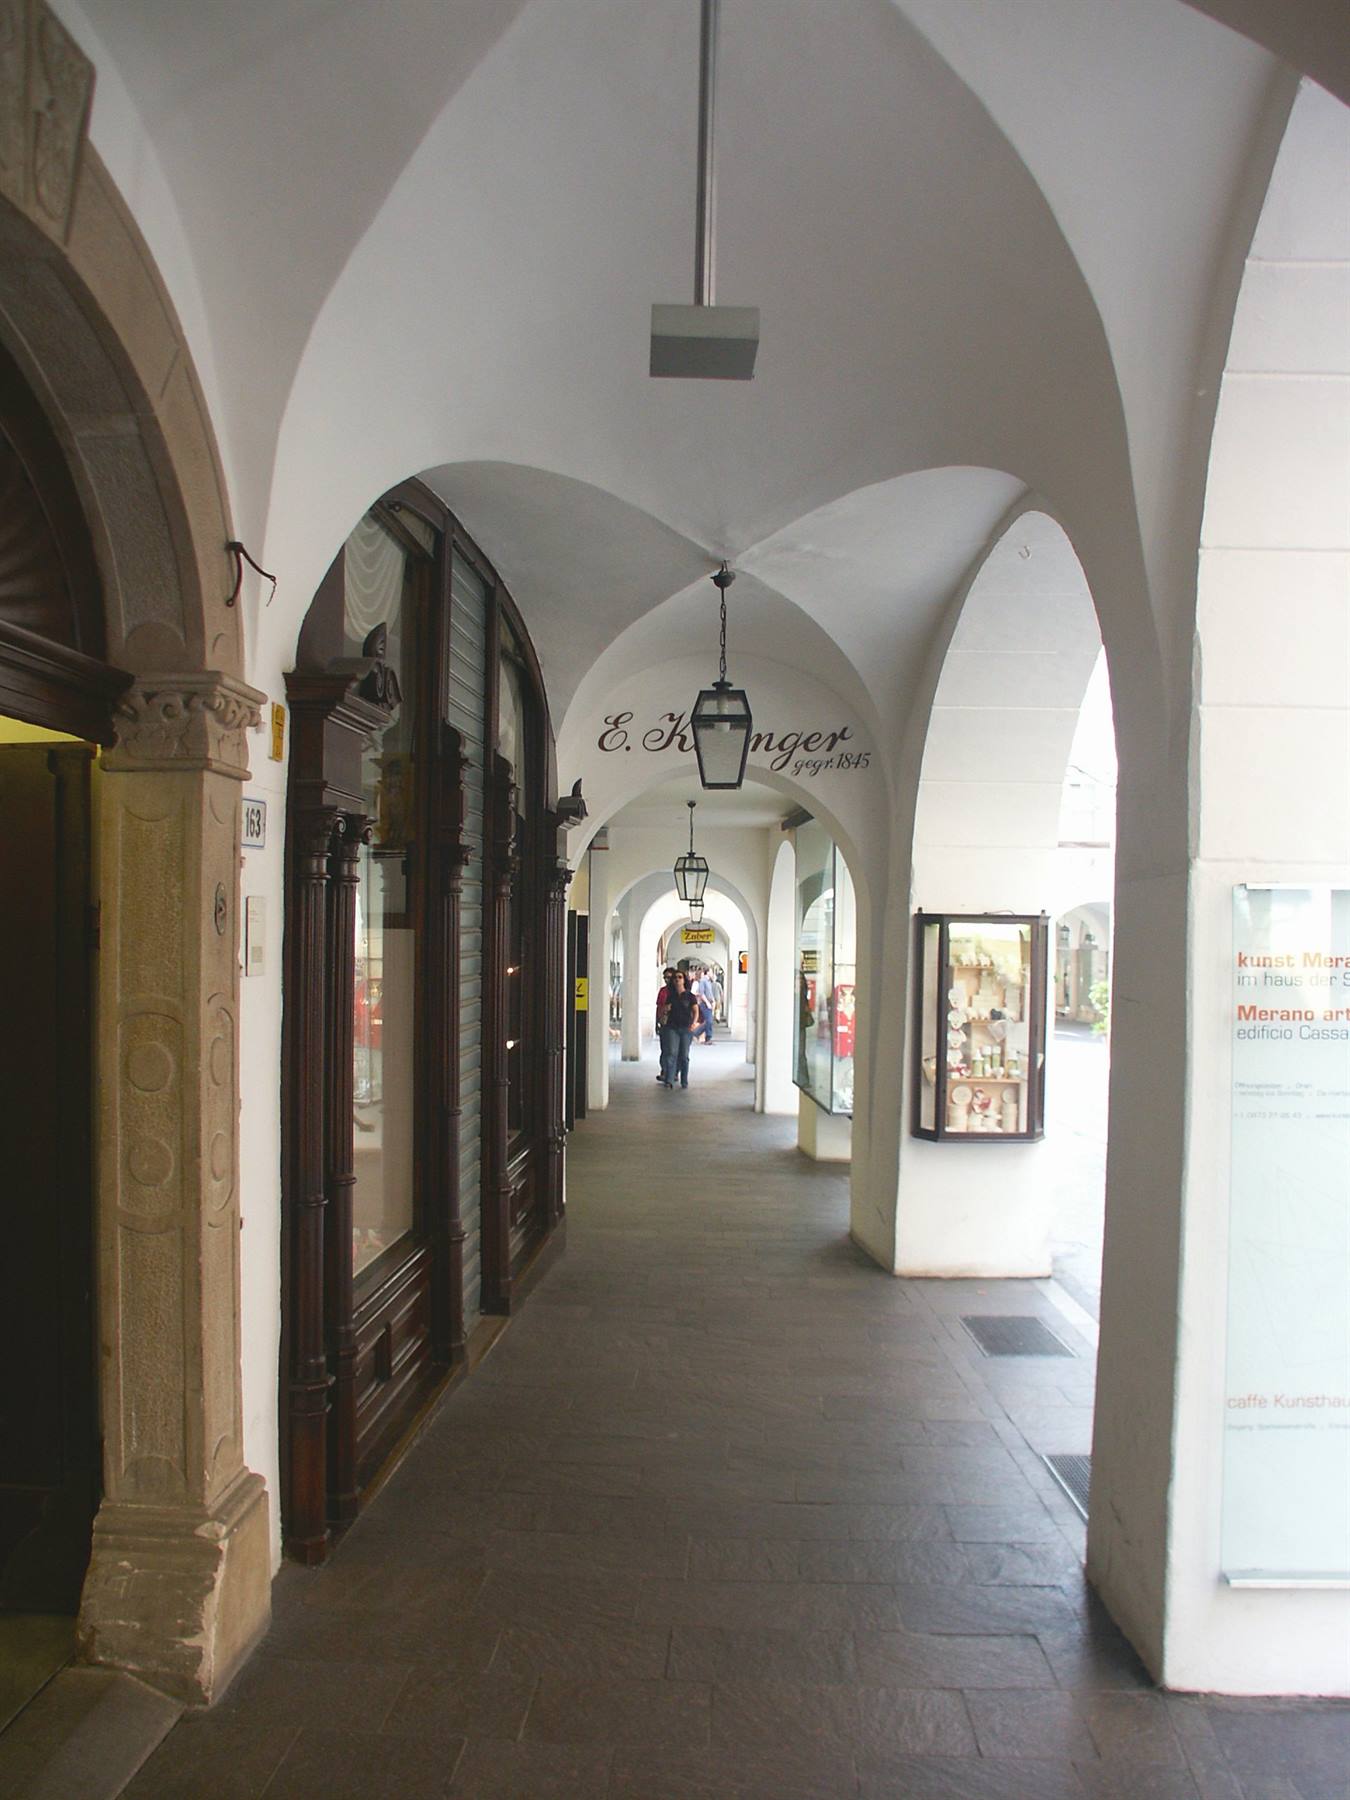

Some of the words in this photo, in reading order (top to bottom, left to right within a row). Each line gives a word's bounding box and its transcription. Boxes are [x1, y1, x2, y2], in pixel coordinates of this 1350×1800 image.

[597, 711, 634, 752] E.
[246, 807, 261, 838] 163
[1237, 951, 1295, 968] kunst
[1237, 971, 1257, 986] im
[1264, 971, 1303, 987] haus
[1310, 972, 1337, 987] der
[1237, 1005, 1315, 1021] Merano
[1236, 1025, 1293, 1040] edificio
